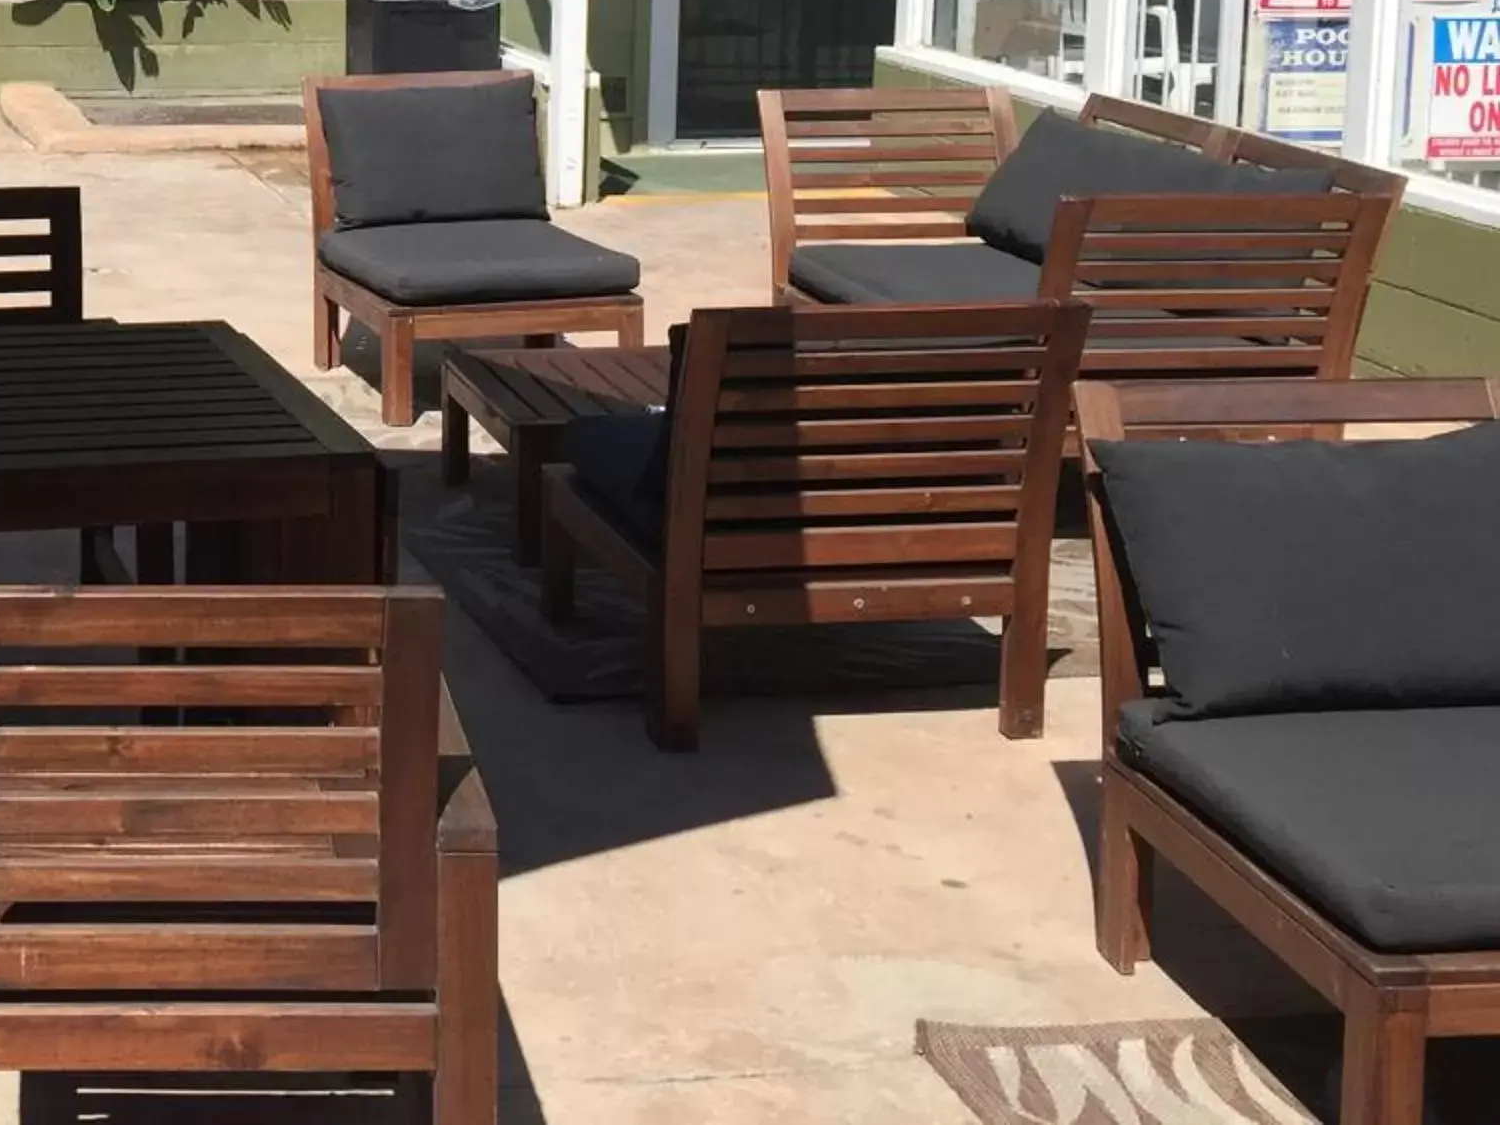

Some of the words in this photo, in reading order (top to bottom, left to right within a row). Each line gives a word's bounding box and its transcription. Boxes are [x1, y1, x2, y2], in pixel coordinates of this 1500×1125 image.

[1447, 20, 1500, 61] WA
[1434, 65, 1470, 96] NO
[1470, 101, 1500, 132] ON
